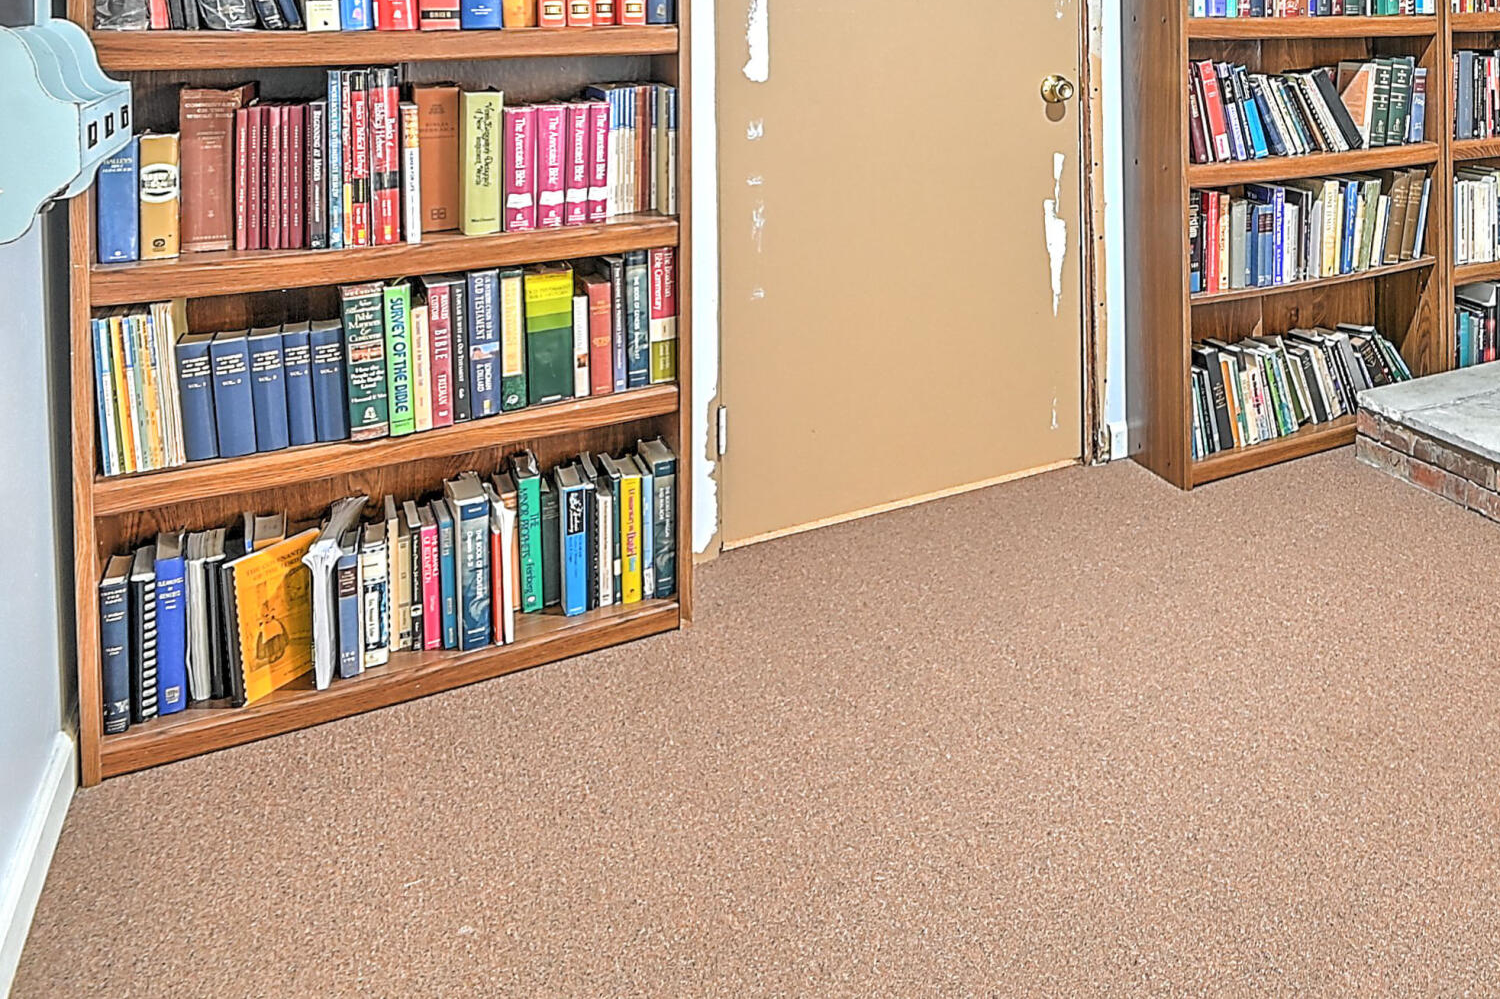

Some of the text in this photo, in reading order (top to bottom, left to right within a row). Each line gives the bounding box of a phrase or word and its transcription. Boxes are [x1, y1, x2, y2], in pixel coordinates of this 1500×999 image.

[515, 118, 525, 186] The Annotated Bible
[549, 117, 560, 184] The Annotated Bible
[574, 114, 585, 181] The Annotated Bible
[596, 113, 606, 180] The Annotated Bible
[475, 277, 485, 340] OLD TESTAMENT
[653, 268, 664, 311] Commentary
[349, 320, 380, 330] Manners
[389, 298, 405, 338] SURVEY
[434, 328, 448, 361] BIBLE
[391, 340, 406, 358] OF
[393, 359, 407, 382] THE
[519, 489, 535, 594] MINOR PROPHETS Feinberg
